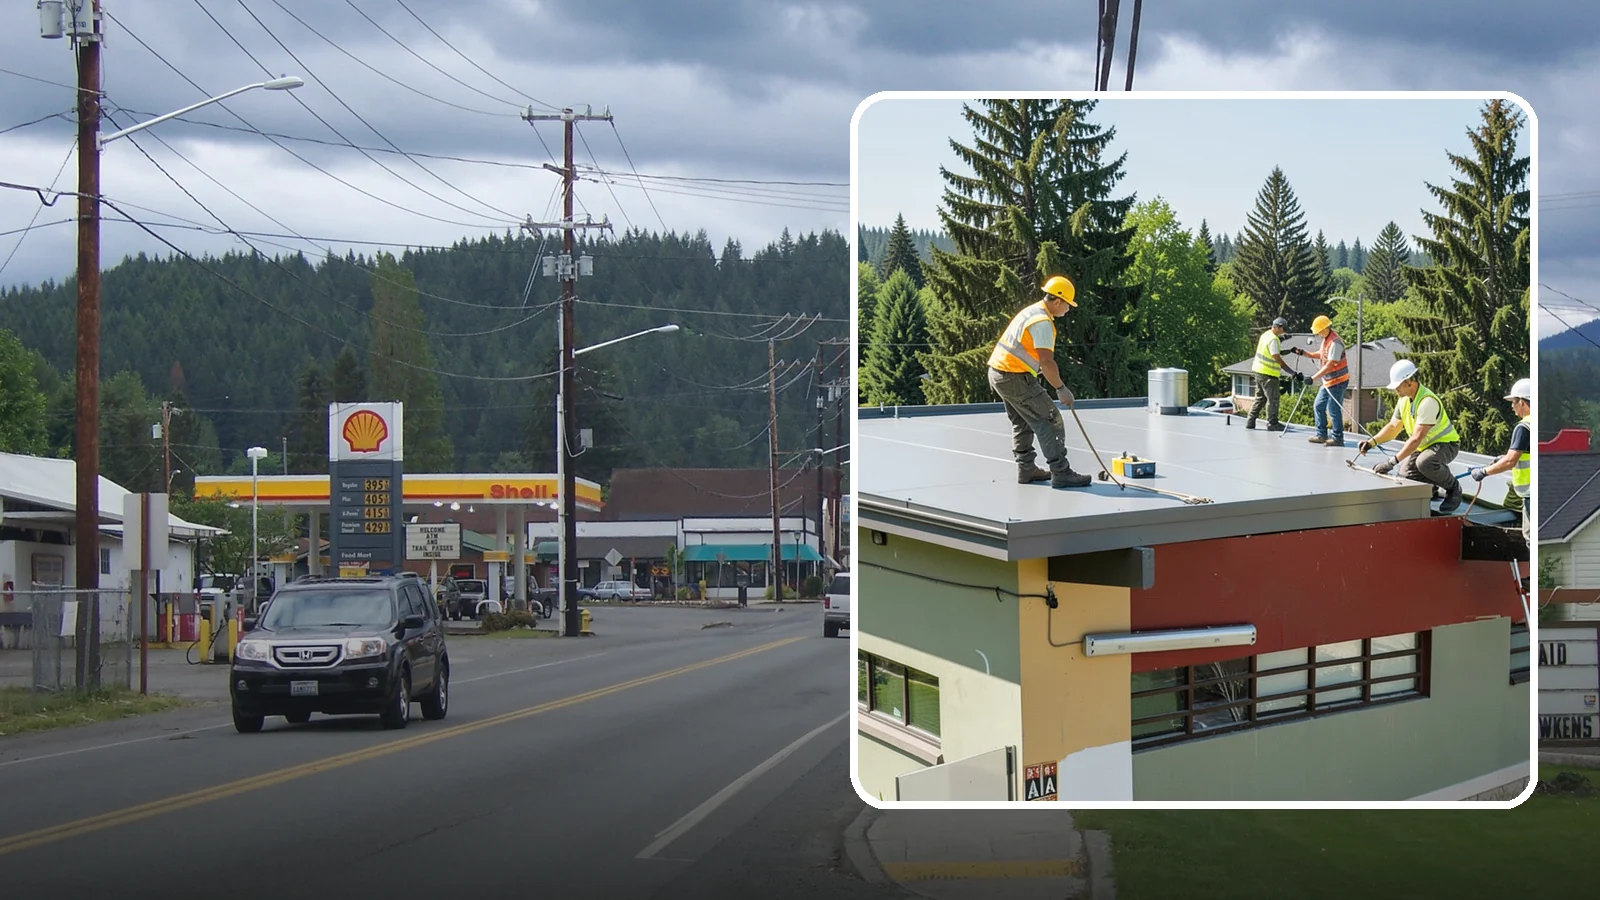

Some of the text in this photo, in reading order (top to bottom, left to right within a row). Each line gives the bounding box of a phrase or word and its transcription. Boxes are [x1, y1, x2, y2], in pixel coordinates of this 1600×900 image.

[365, 480, 384, 490] 395
[490, 485, 547, 499] Shell
[365, 494, 384, 504] 405
[365, 508, 383, 518] 415
[365, 522, 384, 532] 429
